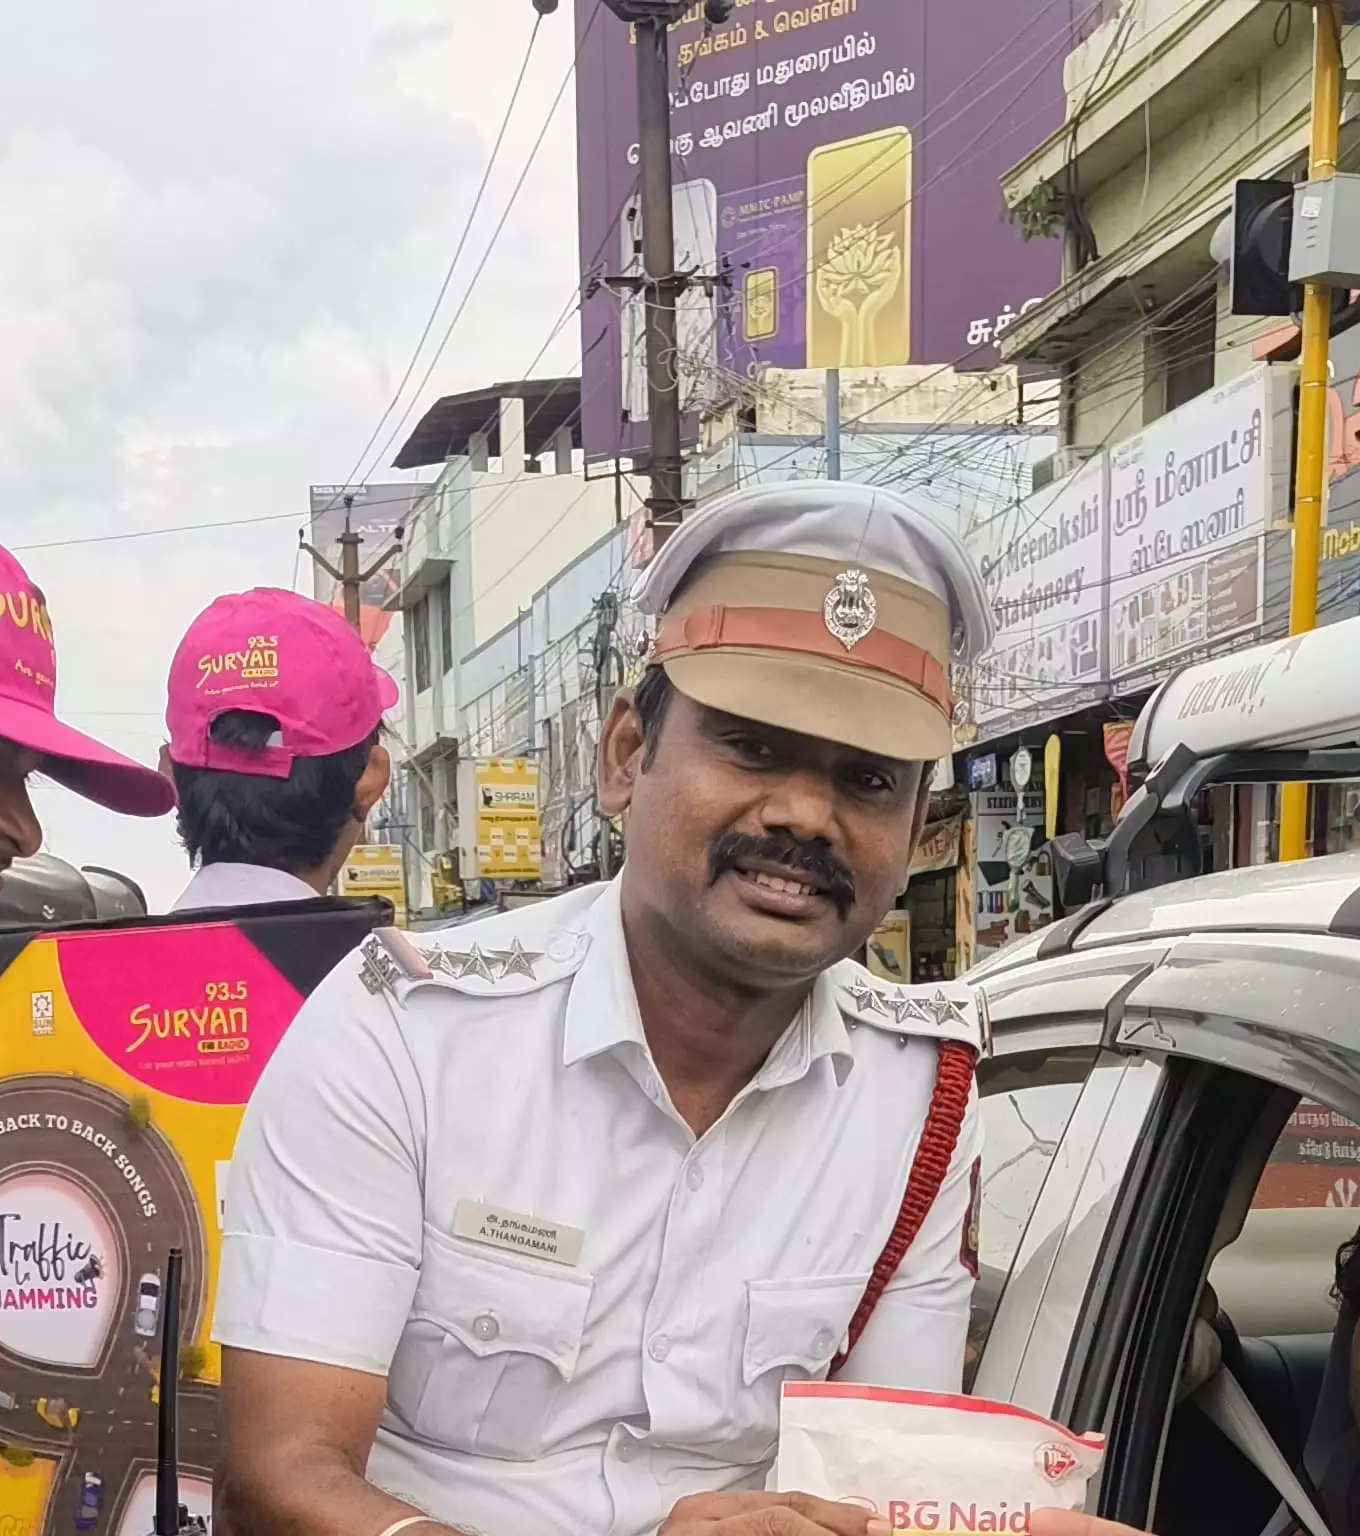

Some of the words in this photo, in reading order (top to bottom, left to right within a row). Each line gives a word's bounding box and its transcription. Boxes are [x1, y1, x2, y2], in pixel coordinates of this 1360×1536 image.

[756, 31, 877, 86] மதுரையில்
[698, 103, 778, 148] ஆவணி
[784, 68, 915, 126] மூலவீதியில்
[1154, 408, 1262, 509] மீனாட்சி
[1005, 493, 1100, 578] Meenakshi
[994, 565, 1086, 632] Stationery
[247, 635, 279, 650] 93.5
[205, 980, 248, 1002] 93.5
[45, 1113, 69, 1131] TO
[69, 1118, 118, 1158] BACK
[114, 1153, 158, 1218] SONGS
[888, 1500, 941, 1532] BG
[949, 1501, 1033, 1533] Naid
